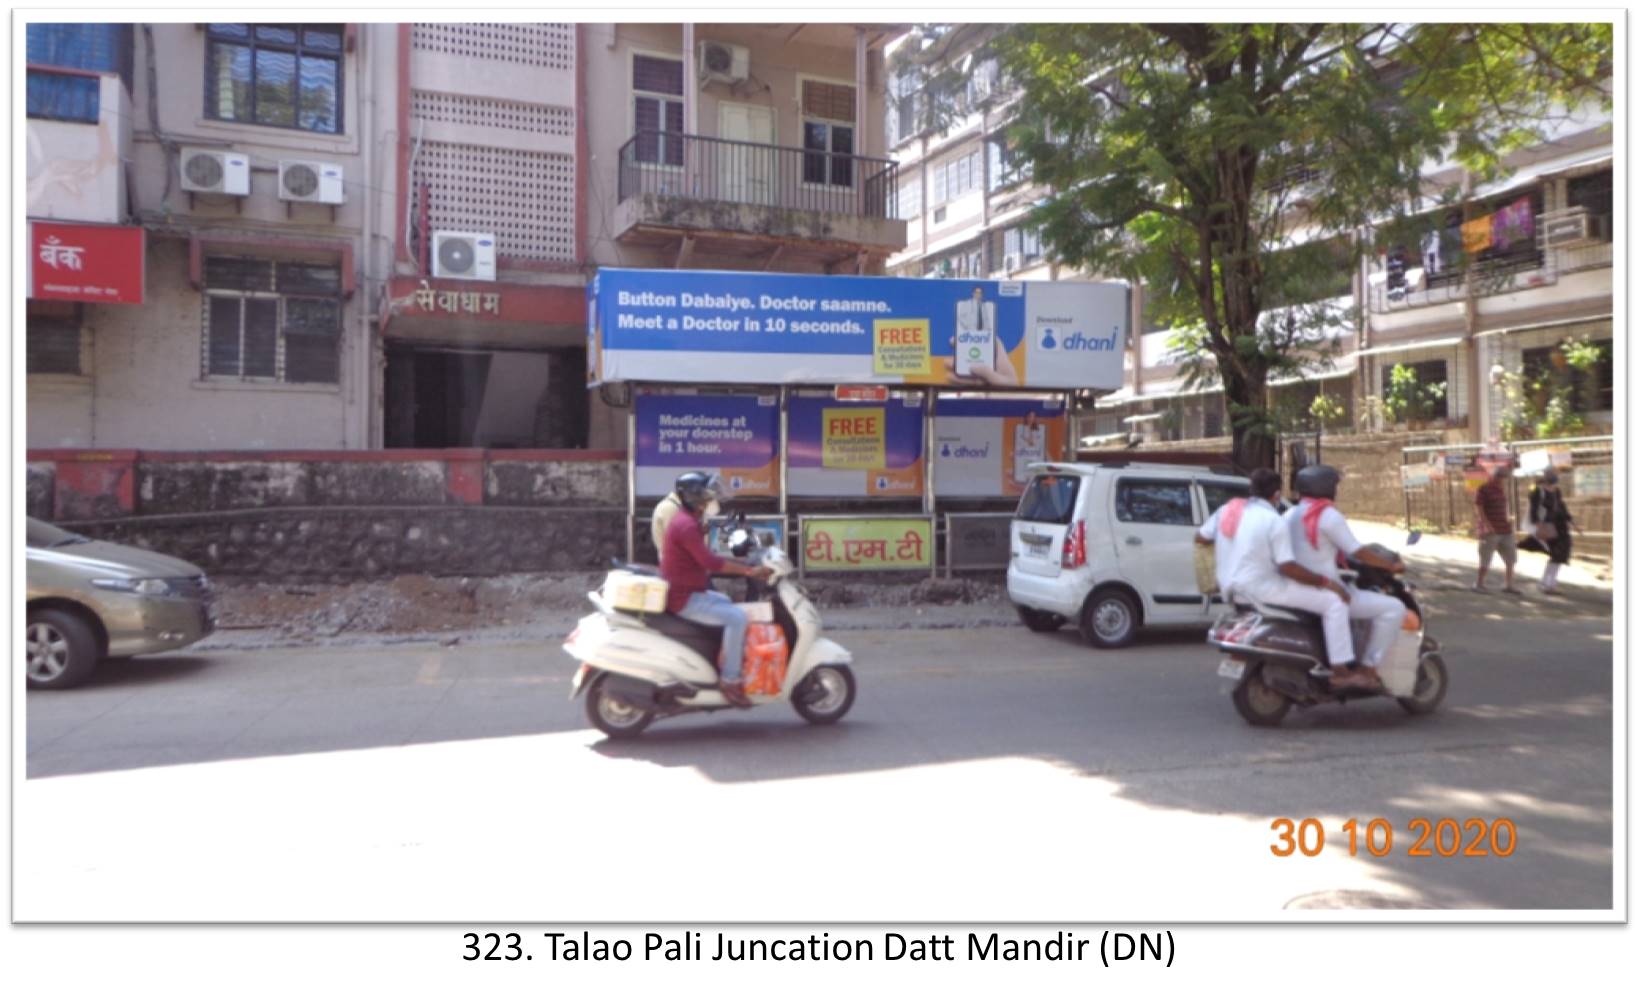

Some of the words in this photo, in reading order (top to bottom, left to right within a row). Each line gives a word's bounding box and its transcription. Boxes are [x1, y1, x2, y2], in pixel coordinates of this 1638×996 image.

[618, 290, 676, 307] Button
[681, 292, 755, 312] Dabaiye.
[760, 295, 816, 311] Doctor
[820, 299, 892, 313] saamne.
[618, 313, 662, 329] Meet
[667, 318, 678, 329] a
[683, 315, 740, 331] Doctor
[744, 317, 760, 332] in
[764, 318, 786, 332] 10
[790, 320, 865, 334] seconds.
[880, 327, 922, 345] FREE
[1063, 326, 1119, 352] dhani
[659, 415, 728, 427] Medicines
[732, 416, 746, 428] at
[829, 416, 876, 436] FREE
[659, 428, 688, 440] your
[692, 428, 753, 442] doorstep
[659, 441, 671, 453] in
[675, 442, 684, 453] 1
[687, 442, 722, 454] hour.
[805, 531, 924, 565] टी.एम.टी
